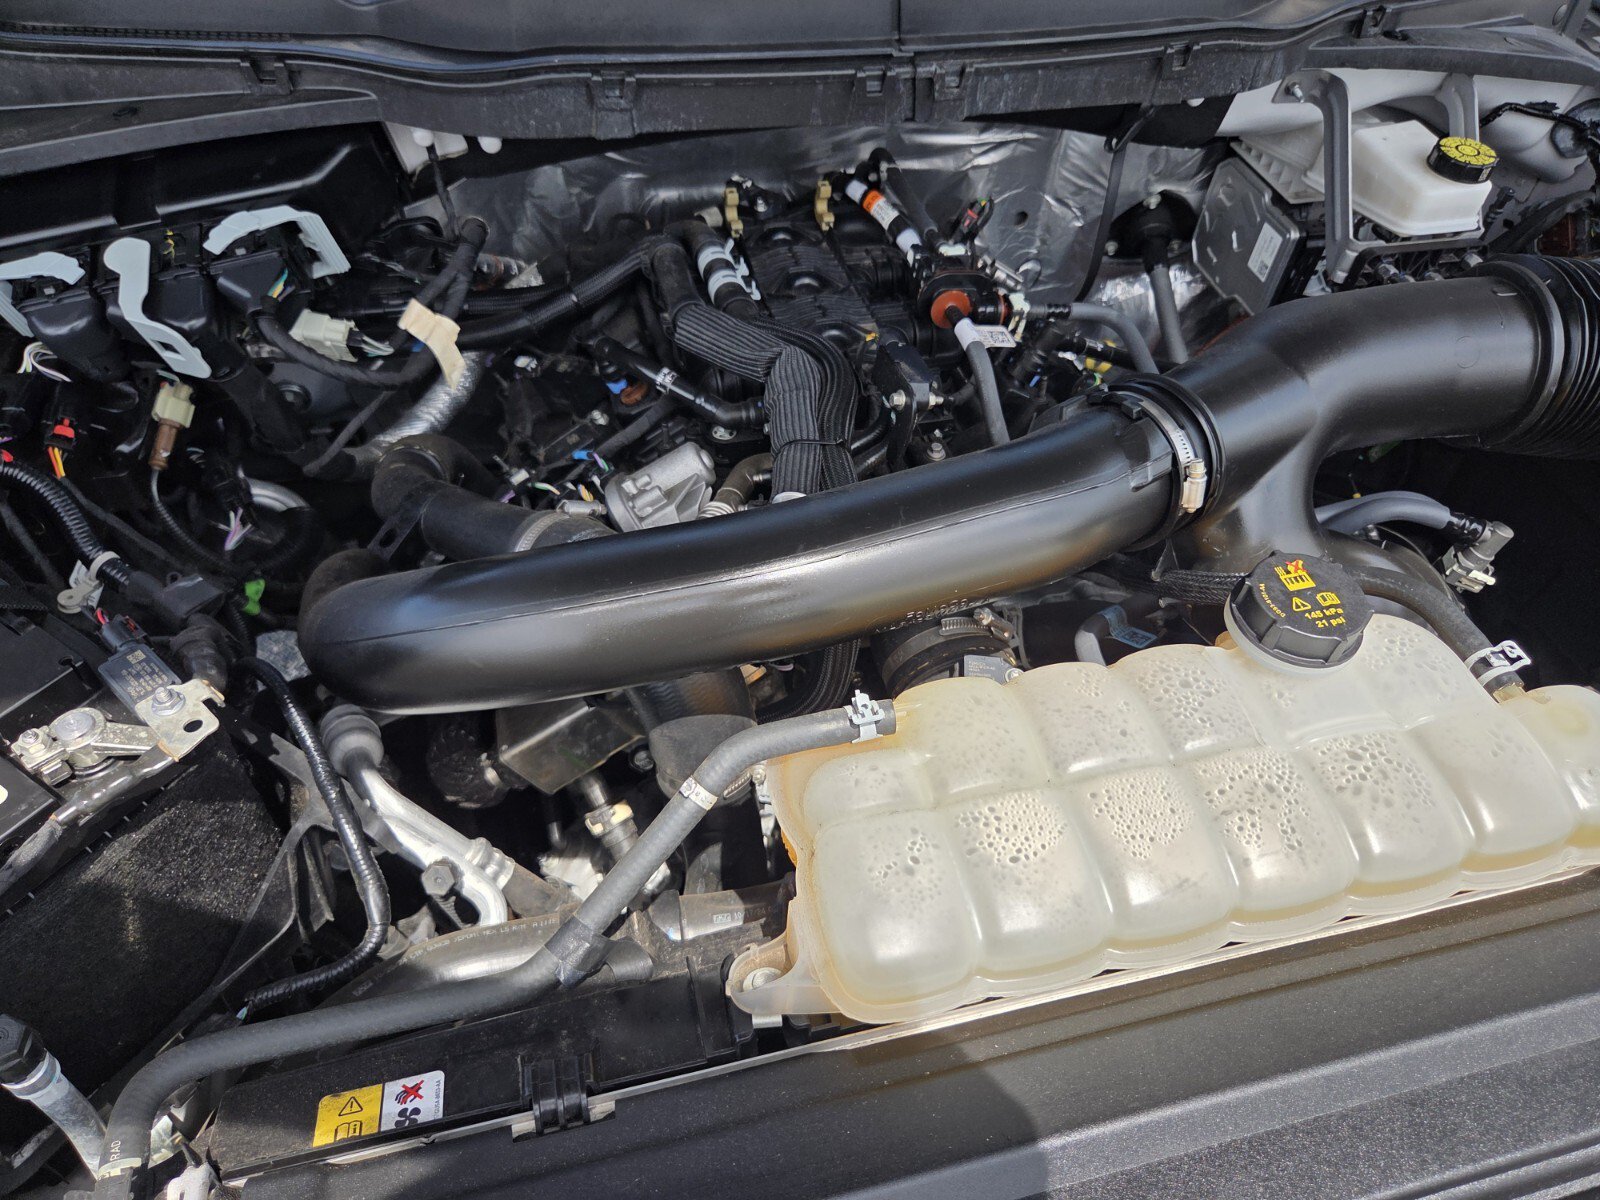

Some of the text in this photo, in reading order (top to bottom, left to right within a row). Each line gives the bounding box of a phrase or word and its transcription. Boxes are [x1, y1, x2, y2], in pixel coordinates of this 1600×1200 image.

[1304, 607, 1344, 619] 145 kPa
[1315, 616, 1346, 628] 21 psi
[110, 1140, 121, 1161] RAD
